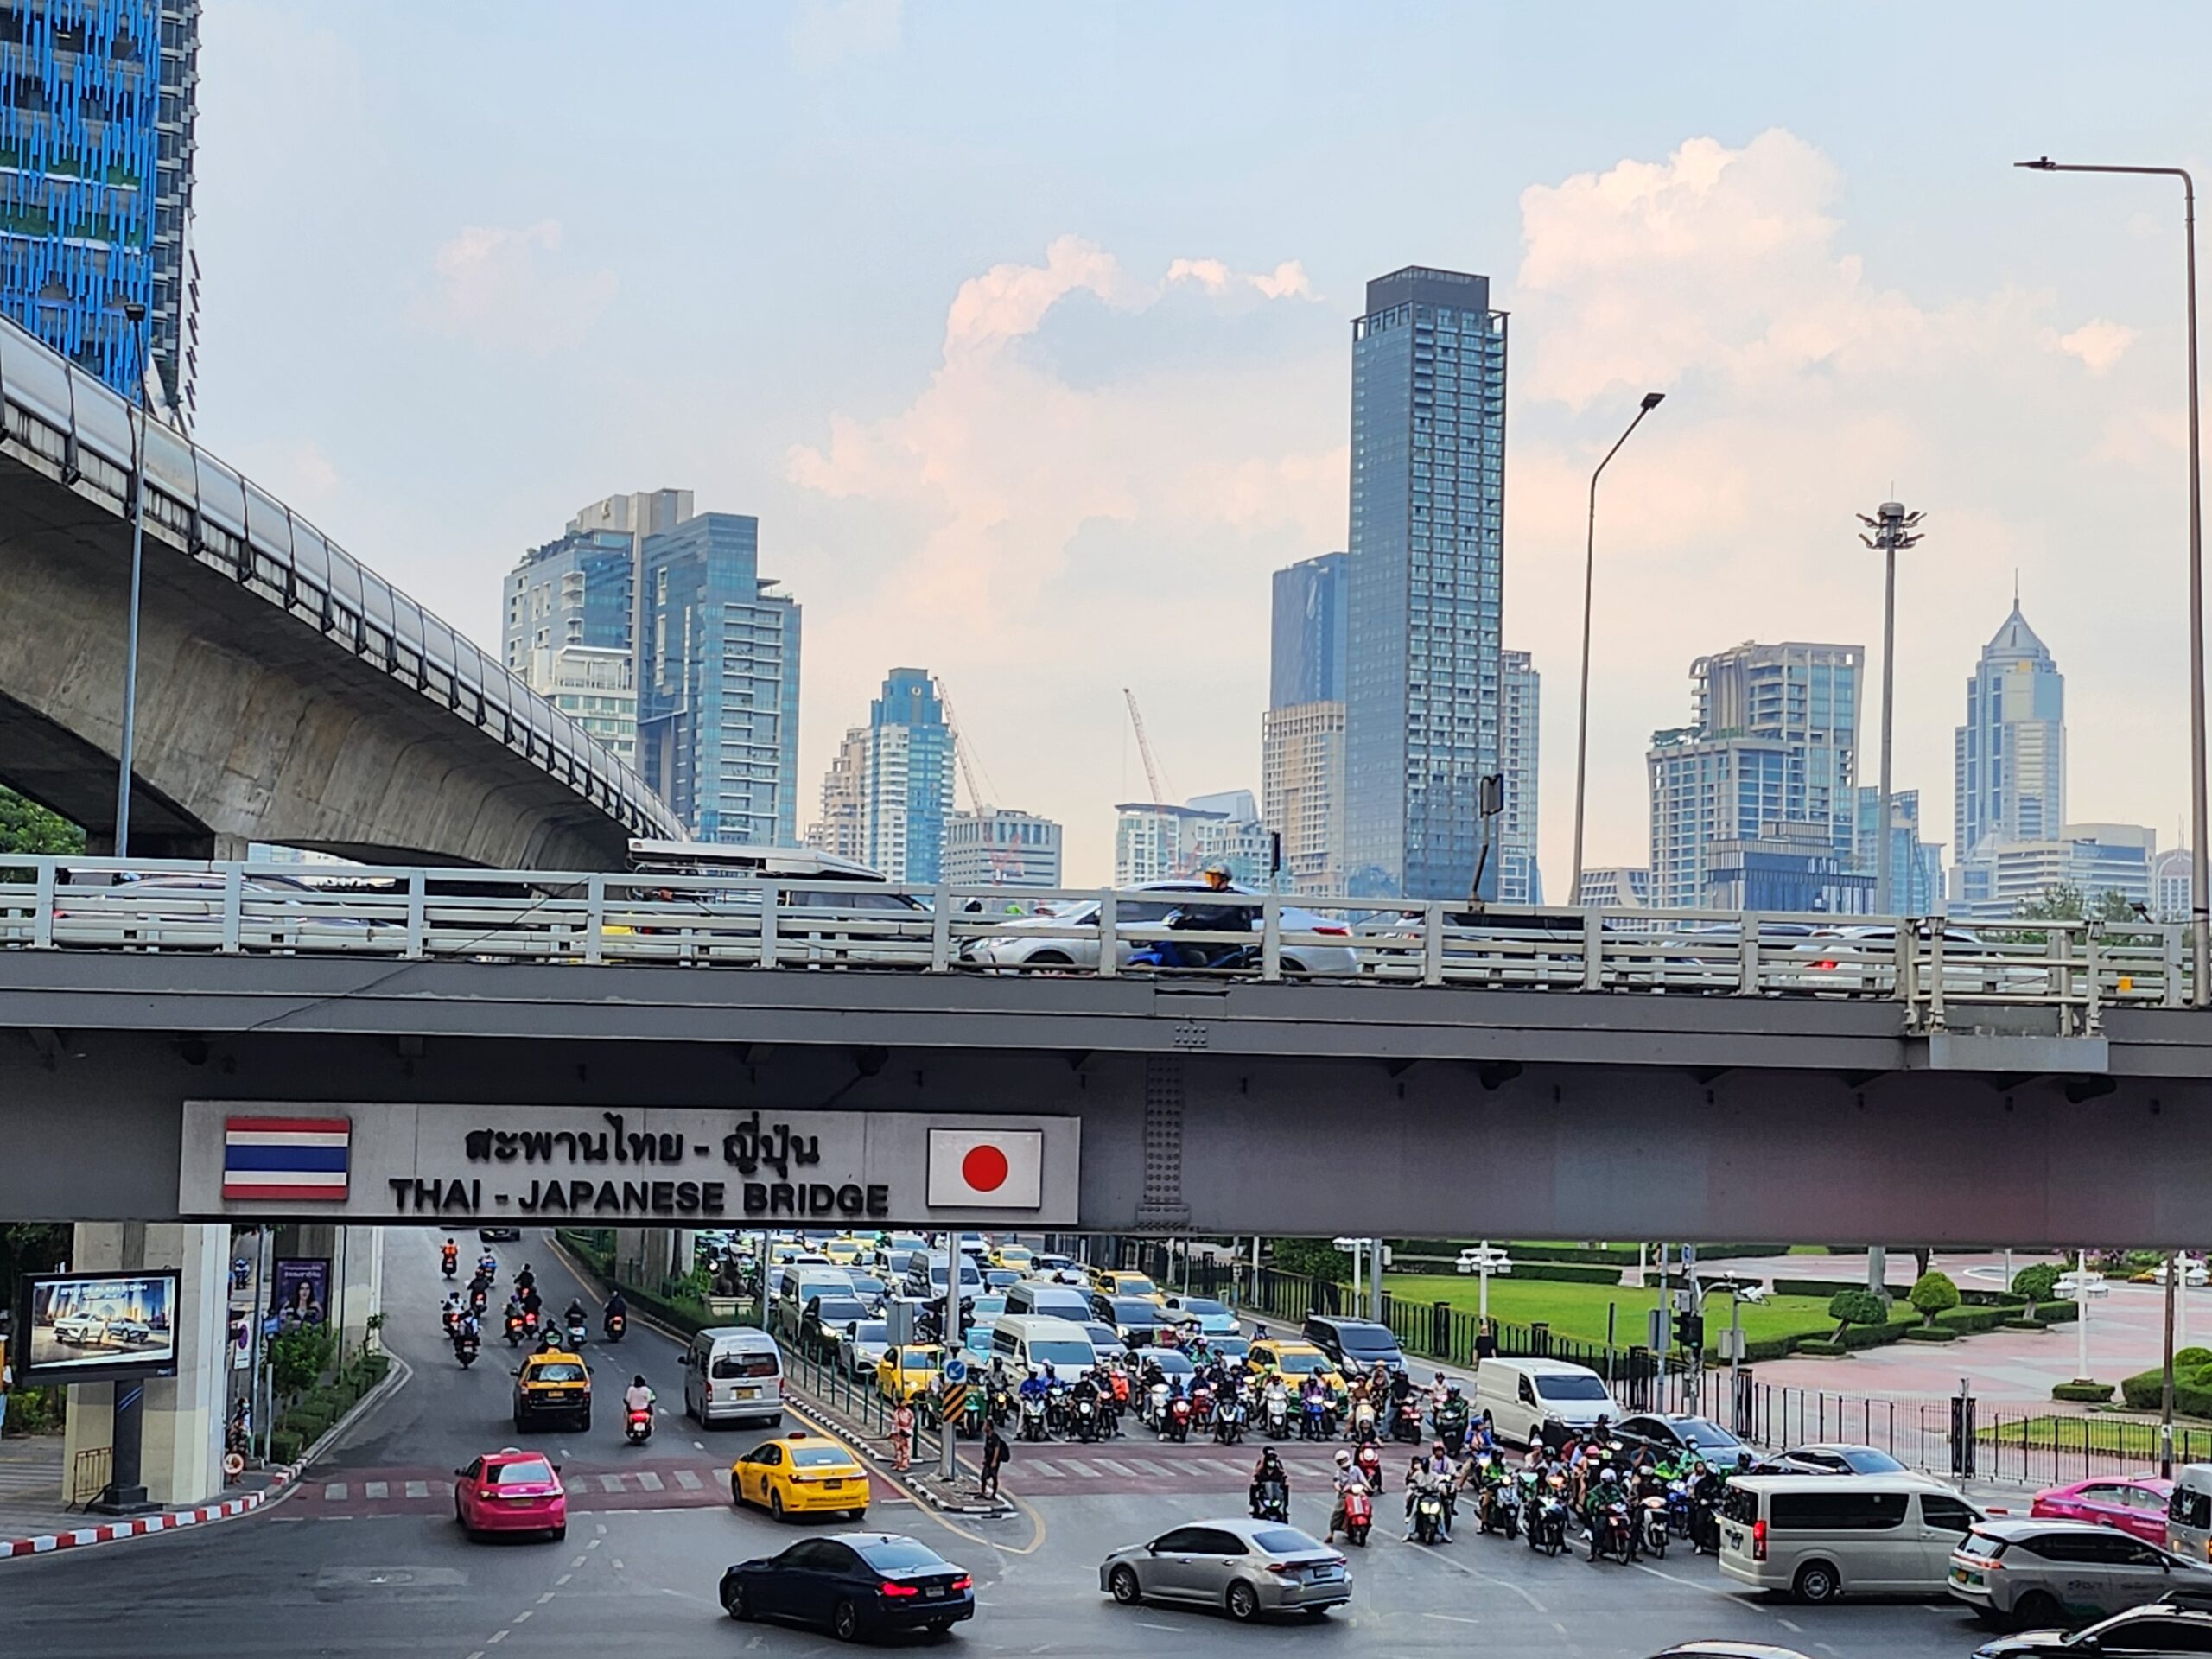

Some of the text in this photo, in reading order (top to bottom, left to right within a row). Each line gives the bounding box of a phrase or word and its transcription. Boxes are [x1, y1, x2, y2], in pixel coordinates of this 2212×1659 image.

[465, 1111, 683, 1161] สะพานไทย
[722, 1111, 820, 1179] ญี่ปุ่น
[389, 1179, 480, 1210] THAI
[518, 1180, 725, 1211] JAPANESE
[744, 1183, 889, 1214] BRIDGE
